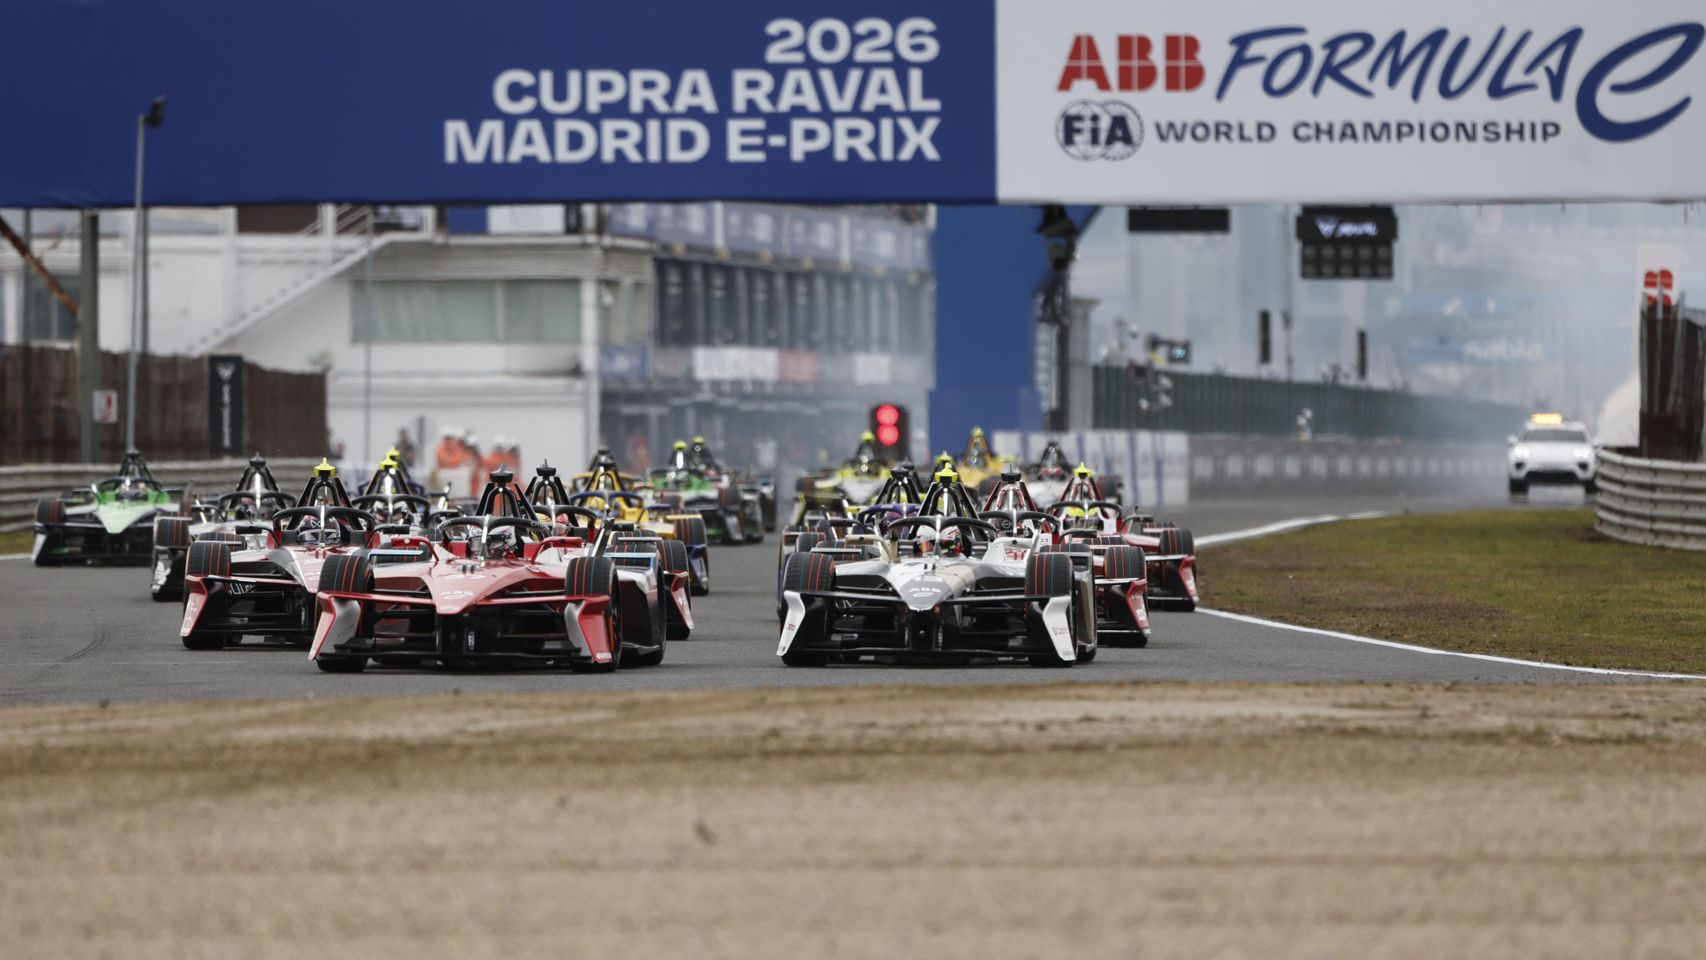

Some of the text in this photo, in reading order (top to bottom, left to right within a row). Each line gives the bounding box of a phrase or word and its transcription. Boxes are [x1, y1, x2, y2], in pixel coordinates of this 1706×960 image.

[765, 17, 941, 63] 2026
[1058, 34, 1206, 92] ABB
[1215, 26, 1584, 104] FORMULA
[493, 67, 941, 114] CUPRA RAVAL
[444, 117, 941, 163] MADRID E-PRIX
[1155, 121, 1562, 143] WORLD CHAMPIONSHIP
